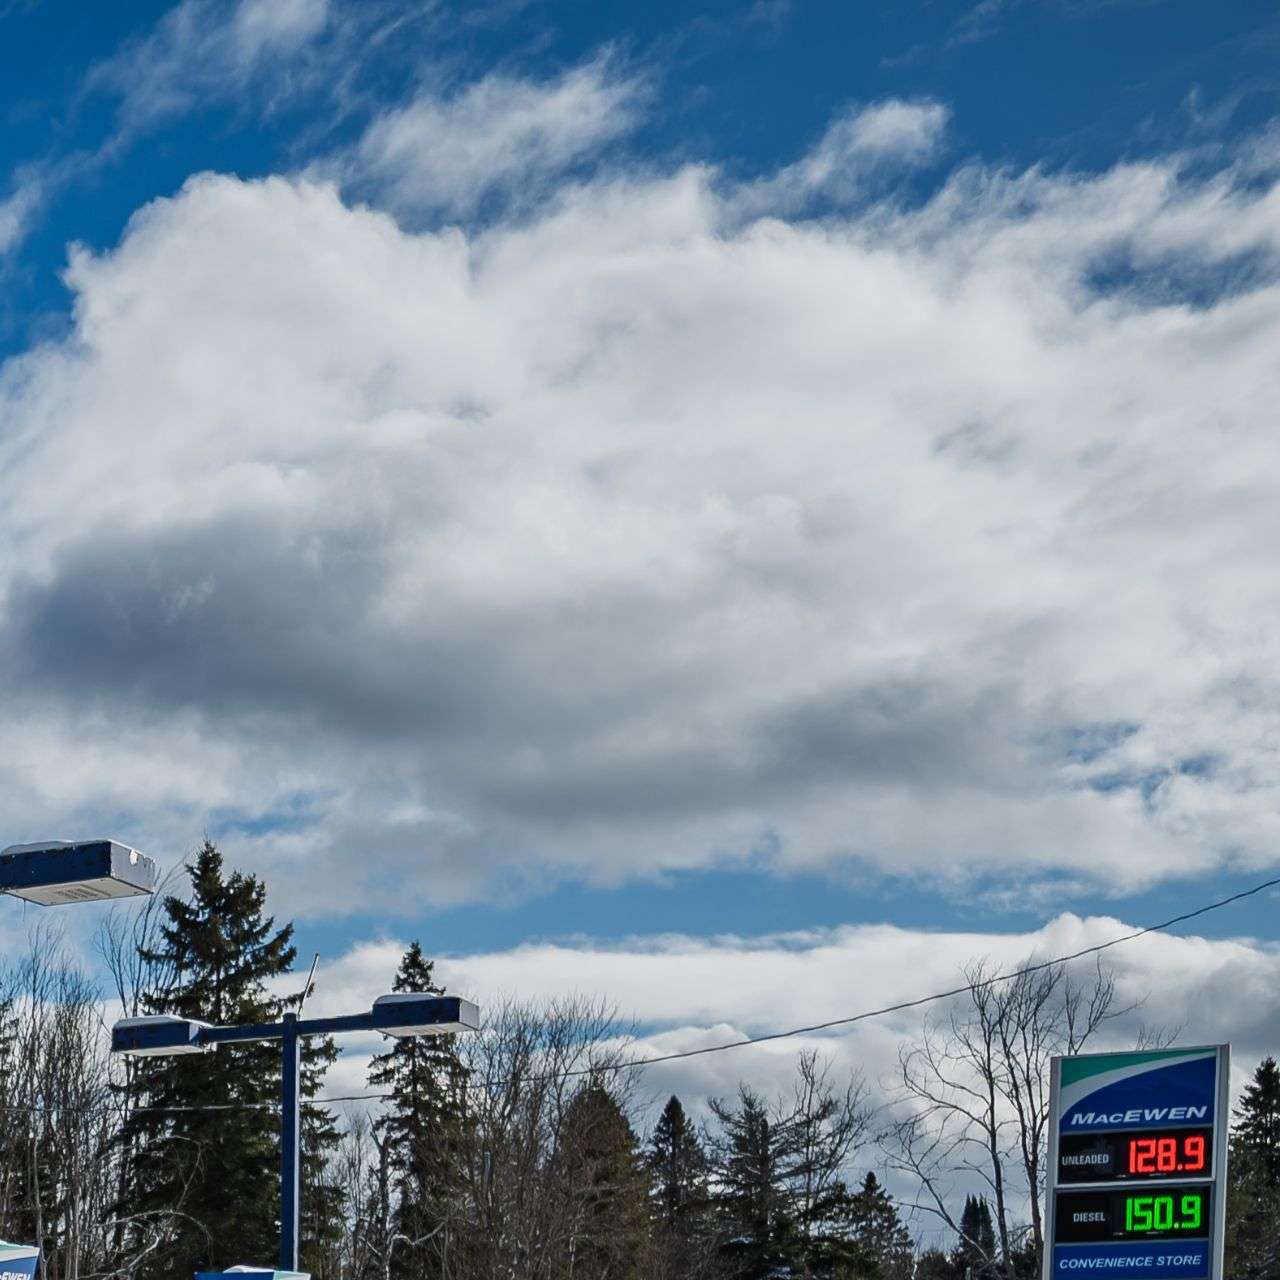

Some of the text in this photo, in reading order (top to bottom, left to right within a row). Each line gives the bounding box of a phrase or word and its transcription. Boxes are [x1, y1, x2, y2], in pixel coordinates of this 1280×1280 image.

[1061, 1153, 1110, 1167] UNLEADED
[1129, 1135, 1205, 1174] 128.9
[1073, 1211, 1106, 1223] DIESEL
[1125, 1195, 1202, 1231] 150.9
[1059, 1254, 1202, 1270] CONVENIENCE STORE
